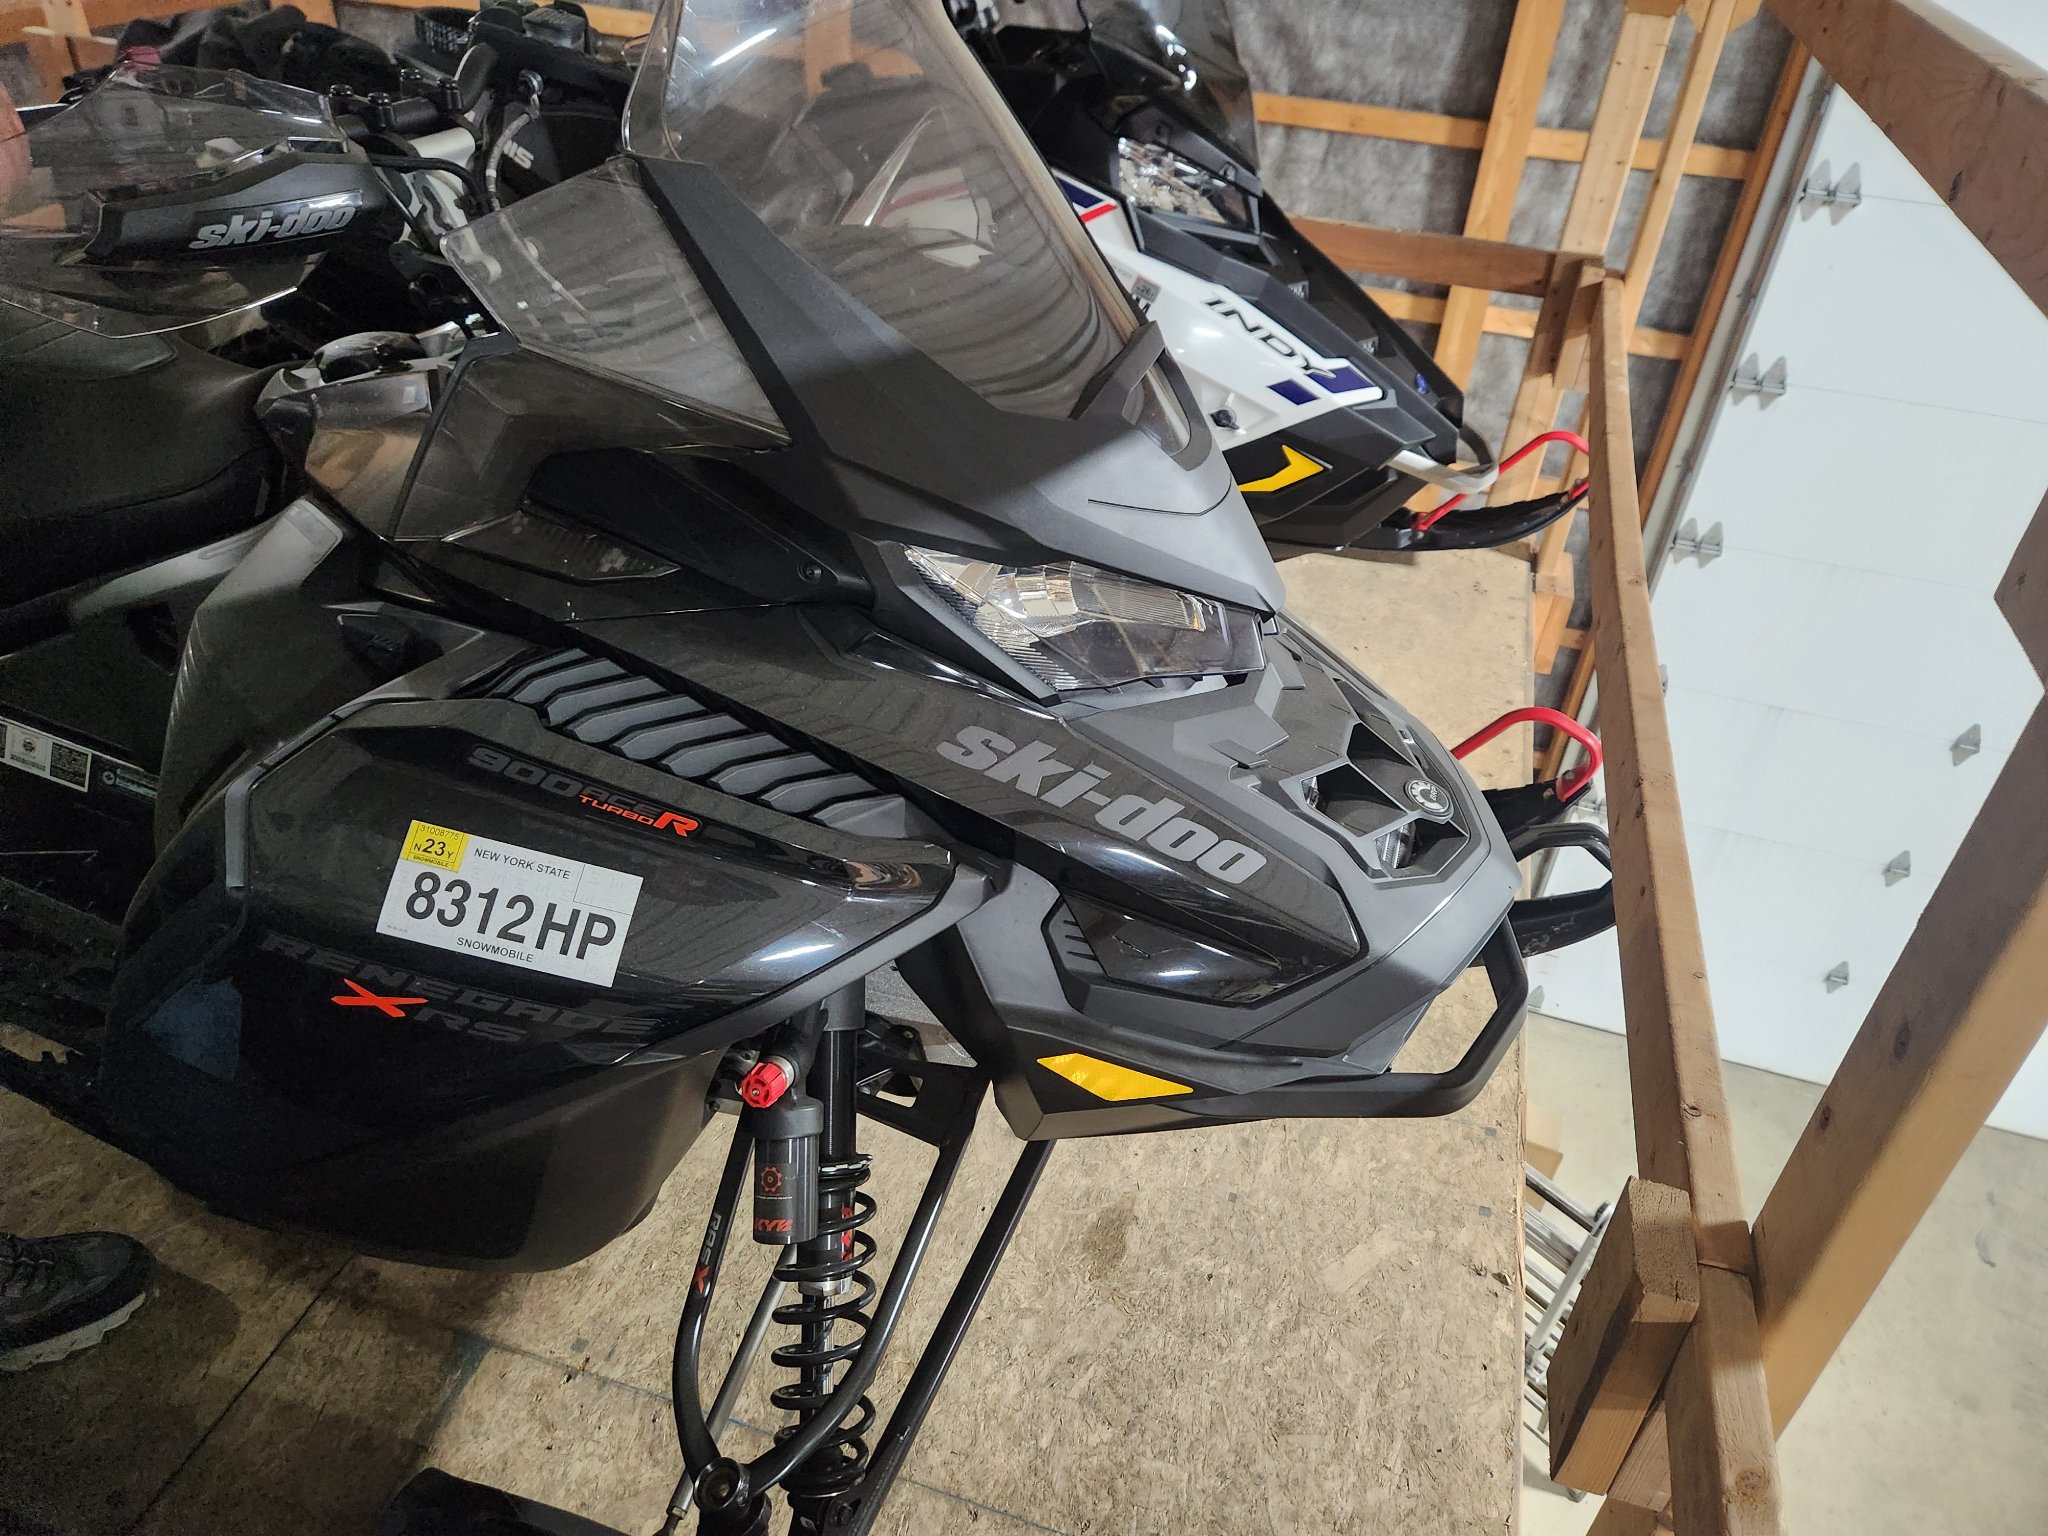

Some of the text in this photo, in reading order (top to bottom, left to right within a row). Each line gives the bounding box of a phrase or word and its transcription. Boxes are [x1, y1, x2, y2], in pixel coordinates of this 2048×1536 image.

[188, 205, 356, 250] ski-doo
[1200, 292, 1337, 379] INDY
[467, 746, 584, 799] 900
[578, 794, 656, 827] TURBO
[936, 724, 1268, 885] ski-doo
[1429, 785, 1438, 802] BRP
[412, 854, 450, 869] SNOWMOBILE
[421, 837, 447, 858] 23
[474, 847, 572, 880] NEW YORK STATE
[405, 871, 617, 961] 8312HP
[456, 936, 534, 963] SNOWMOBILE
[256, 929, 662, 1037] RENEGADE
